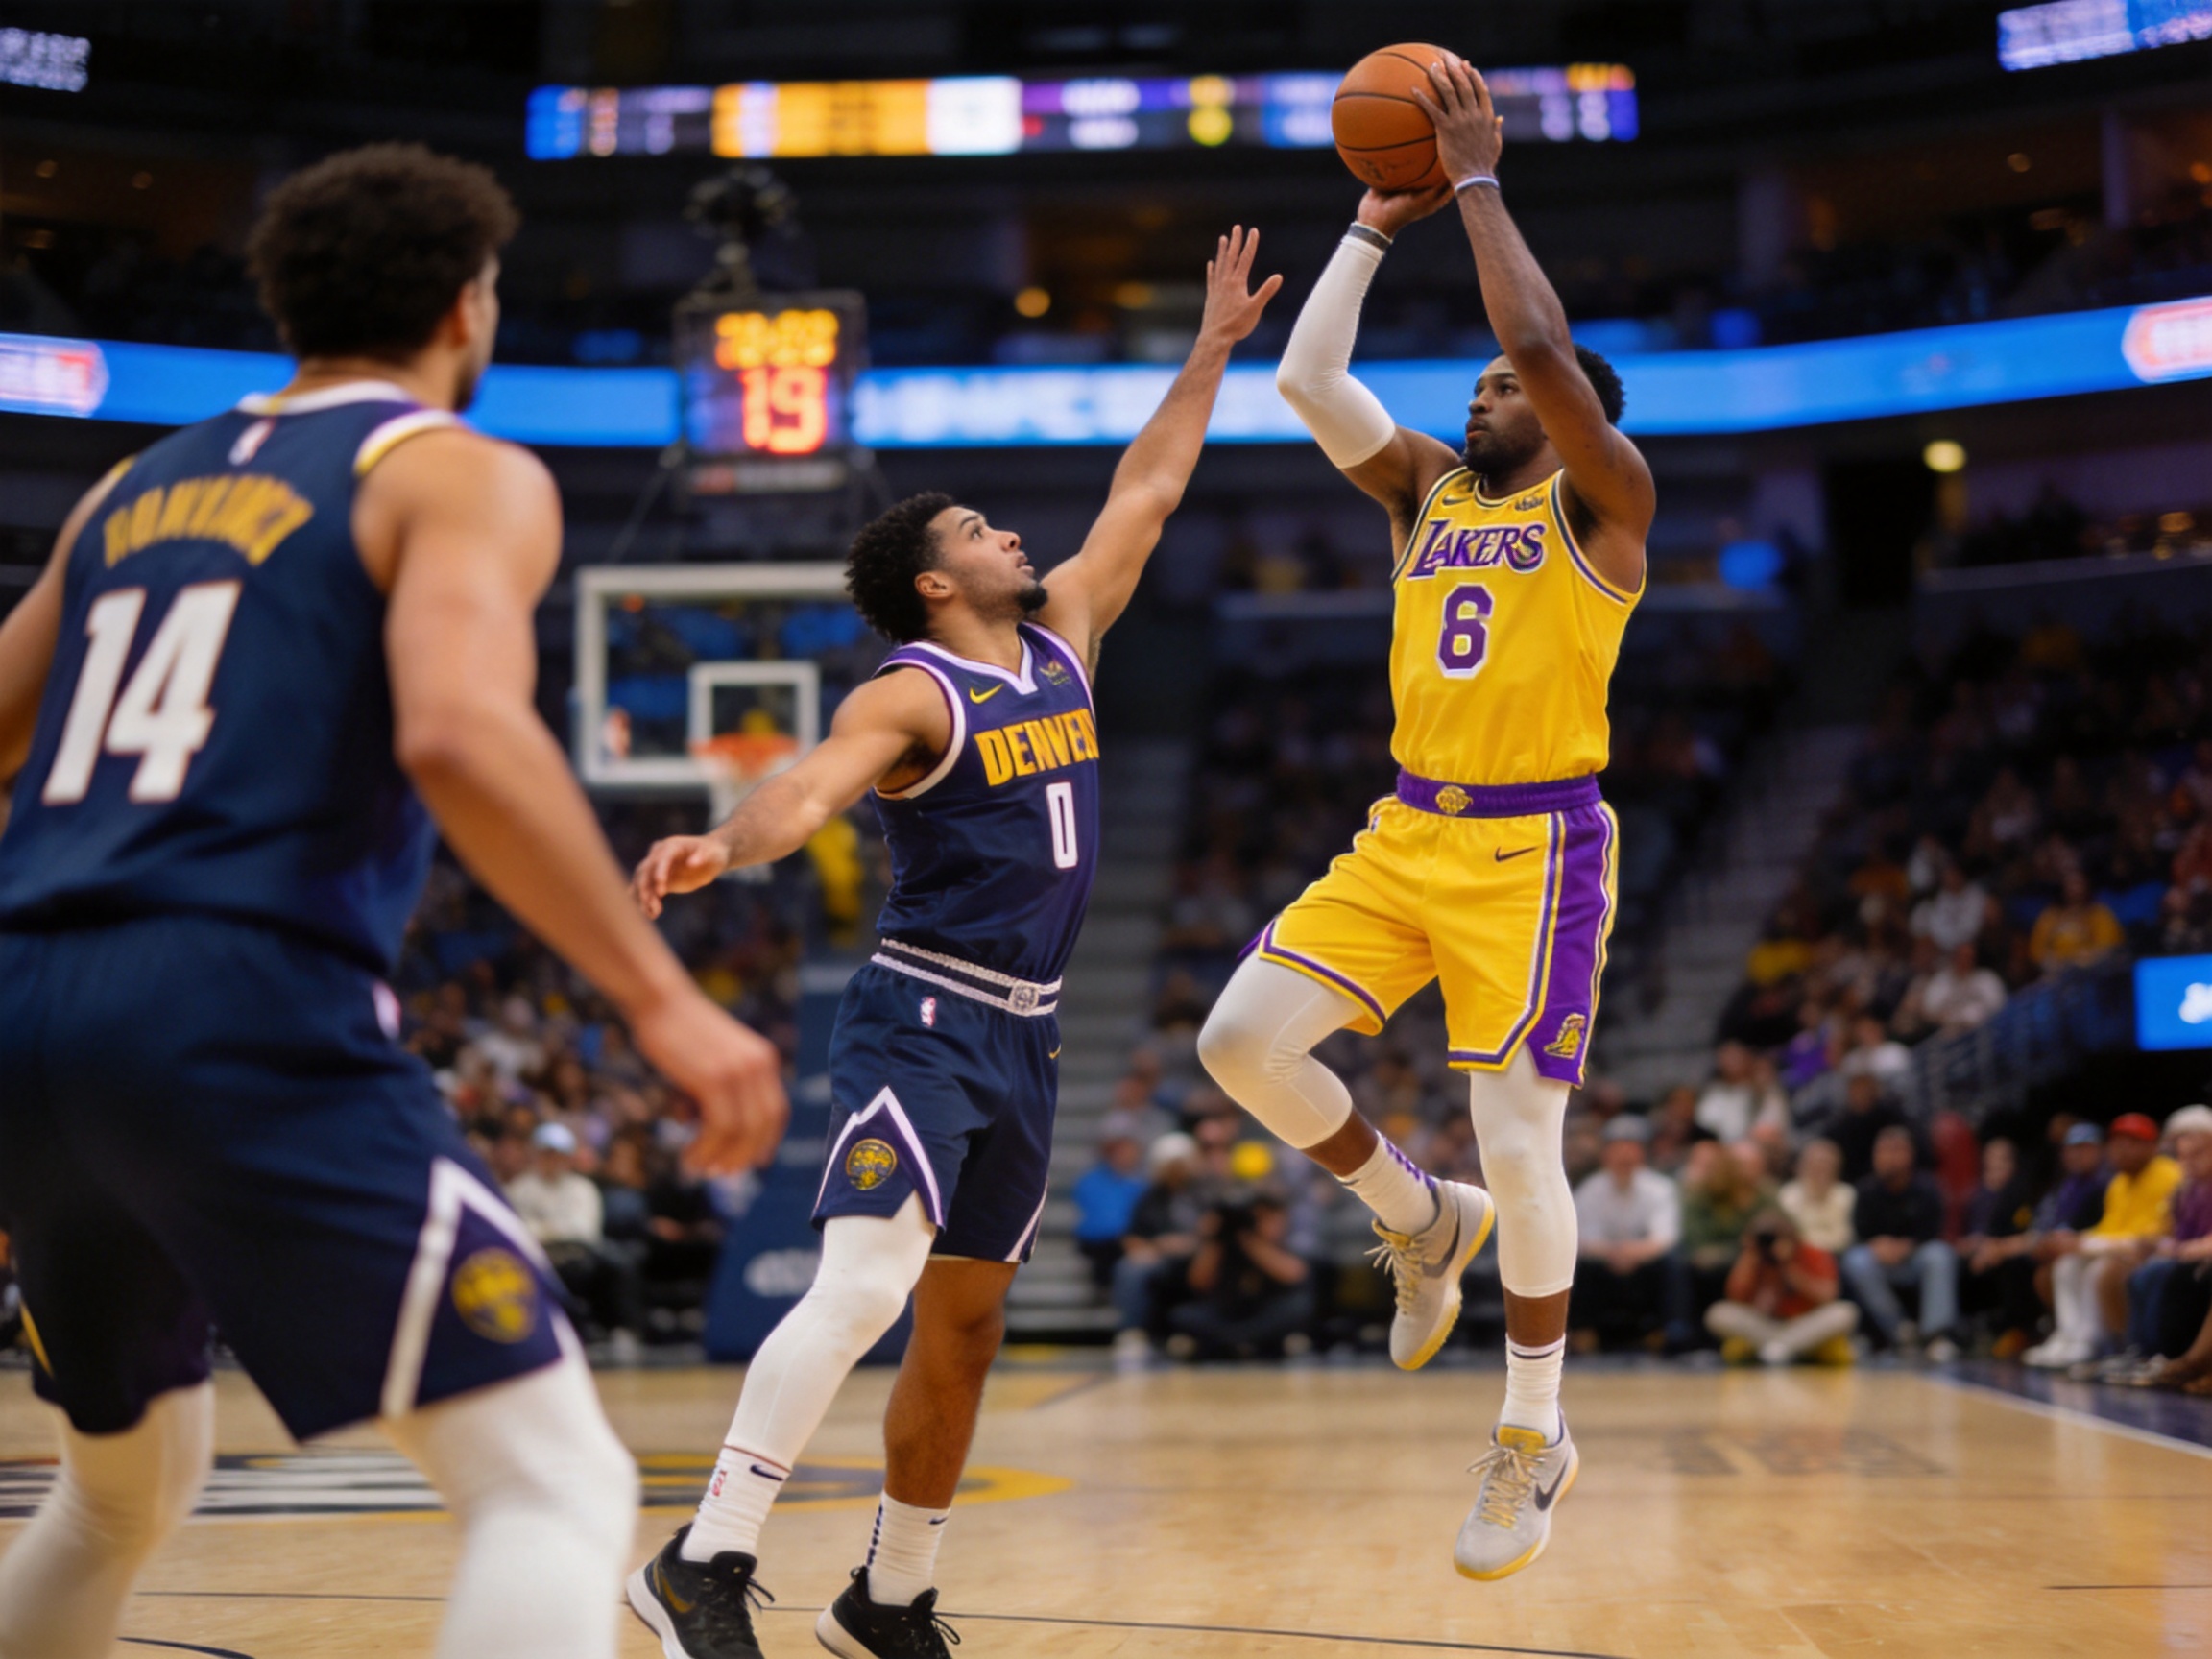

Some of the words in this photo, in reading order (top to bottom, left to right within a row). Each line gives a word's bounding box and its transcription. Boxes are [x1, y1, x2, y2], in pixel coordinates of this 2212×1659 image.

[738, 366, 829, 456] 19
[1406, 517, 1548, 581] LAKERS
[1436, 582, 1495, 680] 6
[41, 577, 244, 806] 14
[1046, 781, 1078, 869] 0
